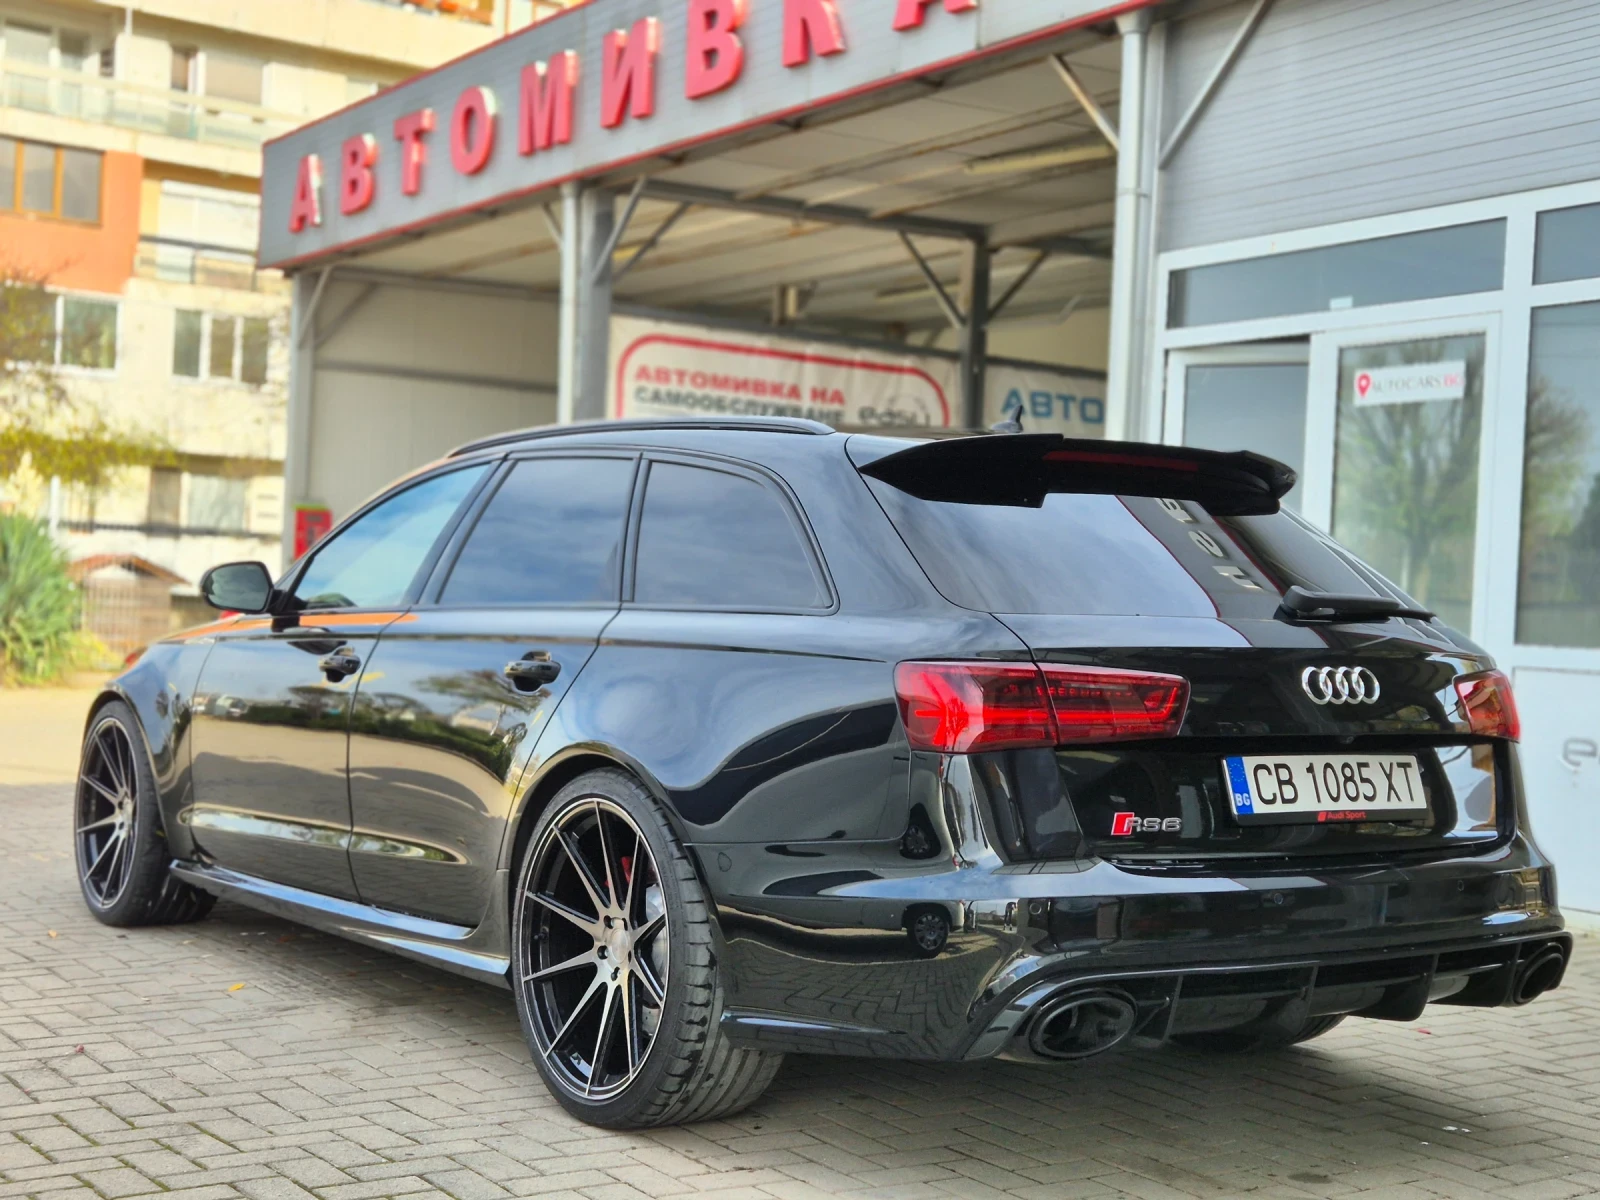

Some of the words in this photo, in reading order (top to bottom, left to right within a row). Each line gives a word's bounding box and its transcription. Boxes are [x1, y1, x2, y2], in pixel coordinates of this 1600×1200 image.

[289, 0, 978, 233] АВТОМИВК
[634, 364, 802, 400] АВТОМИВКА
[809, 386, 845, 406] НА
[1252, 762, 1299, 806] CB
[1305, 761, 1378, 804] 1085
[1378, 761, 1417, 803] XT
[1234, 793, 1251, 807] BG
[1121, 815, 1183, 833] RS6
[1327, 811, 1345, 820] Audi
[1345, 811, 1367, 821] Sport
